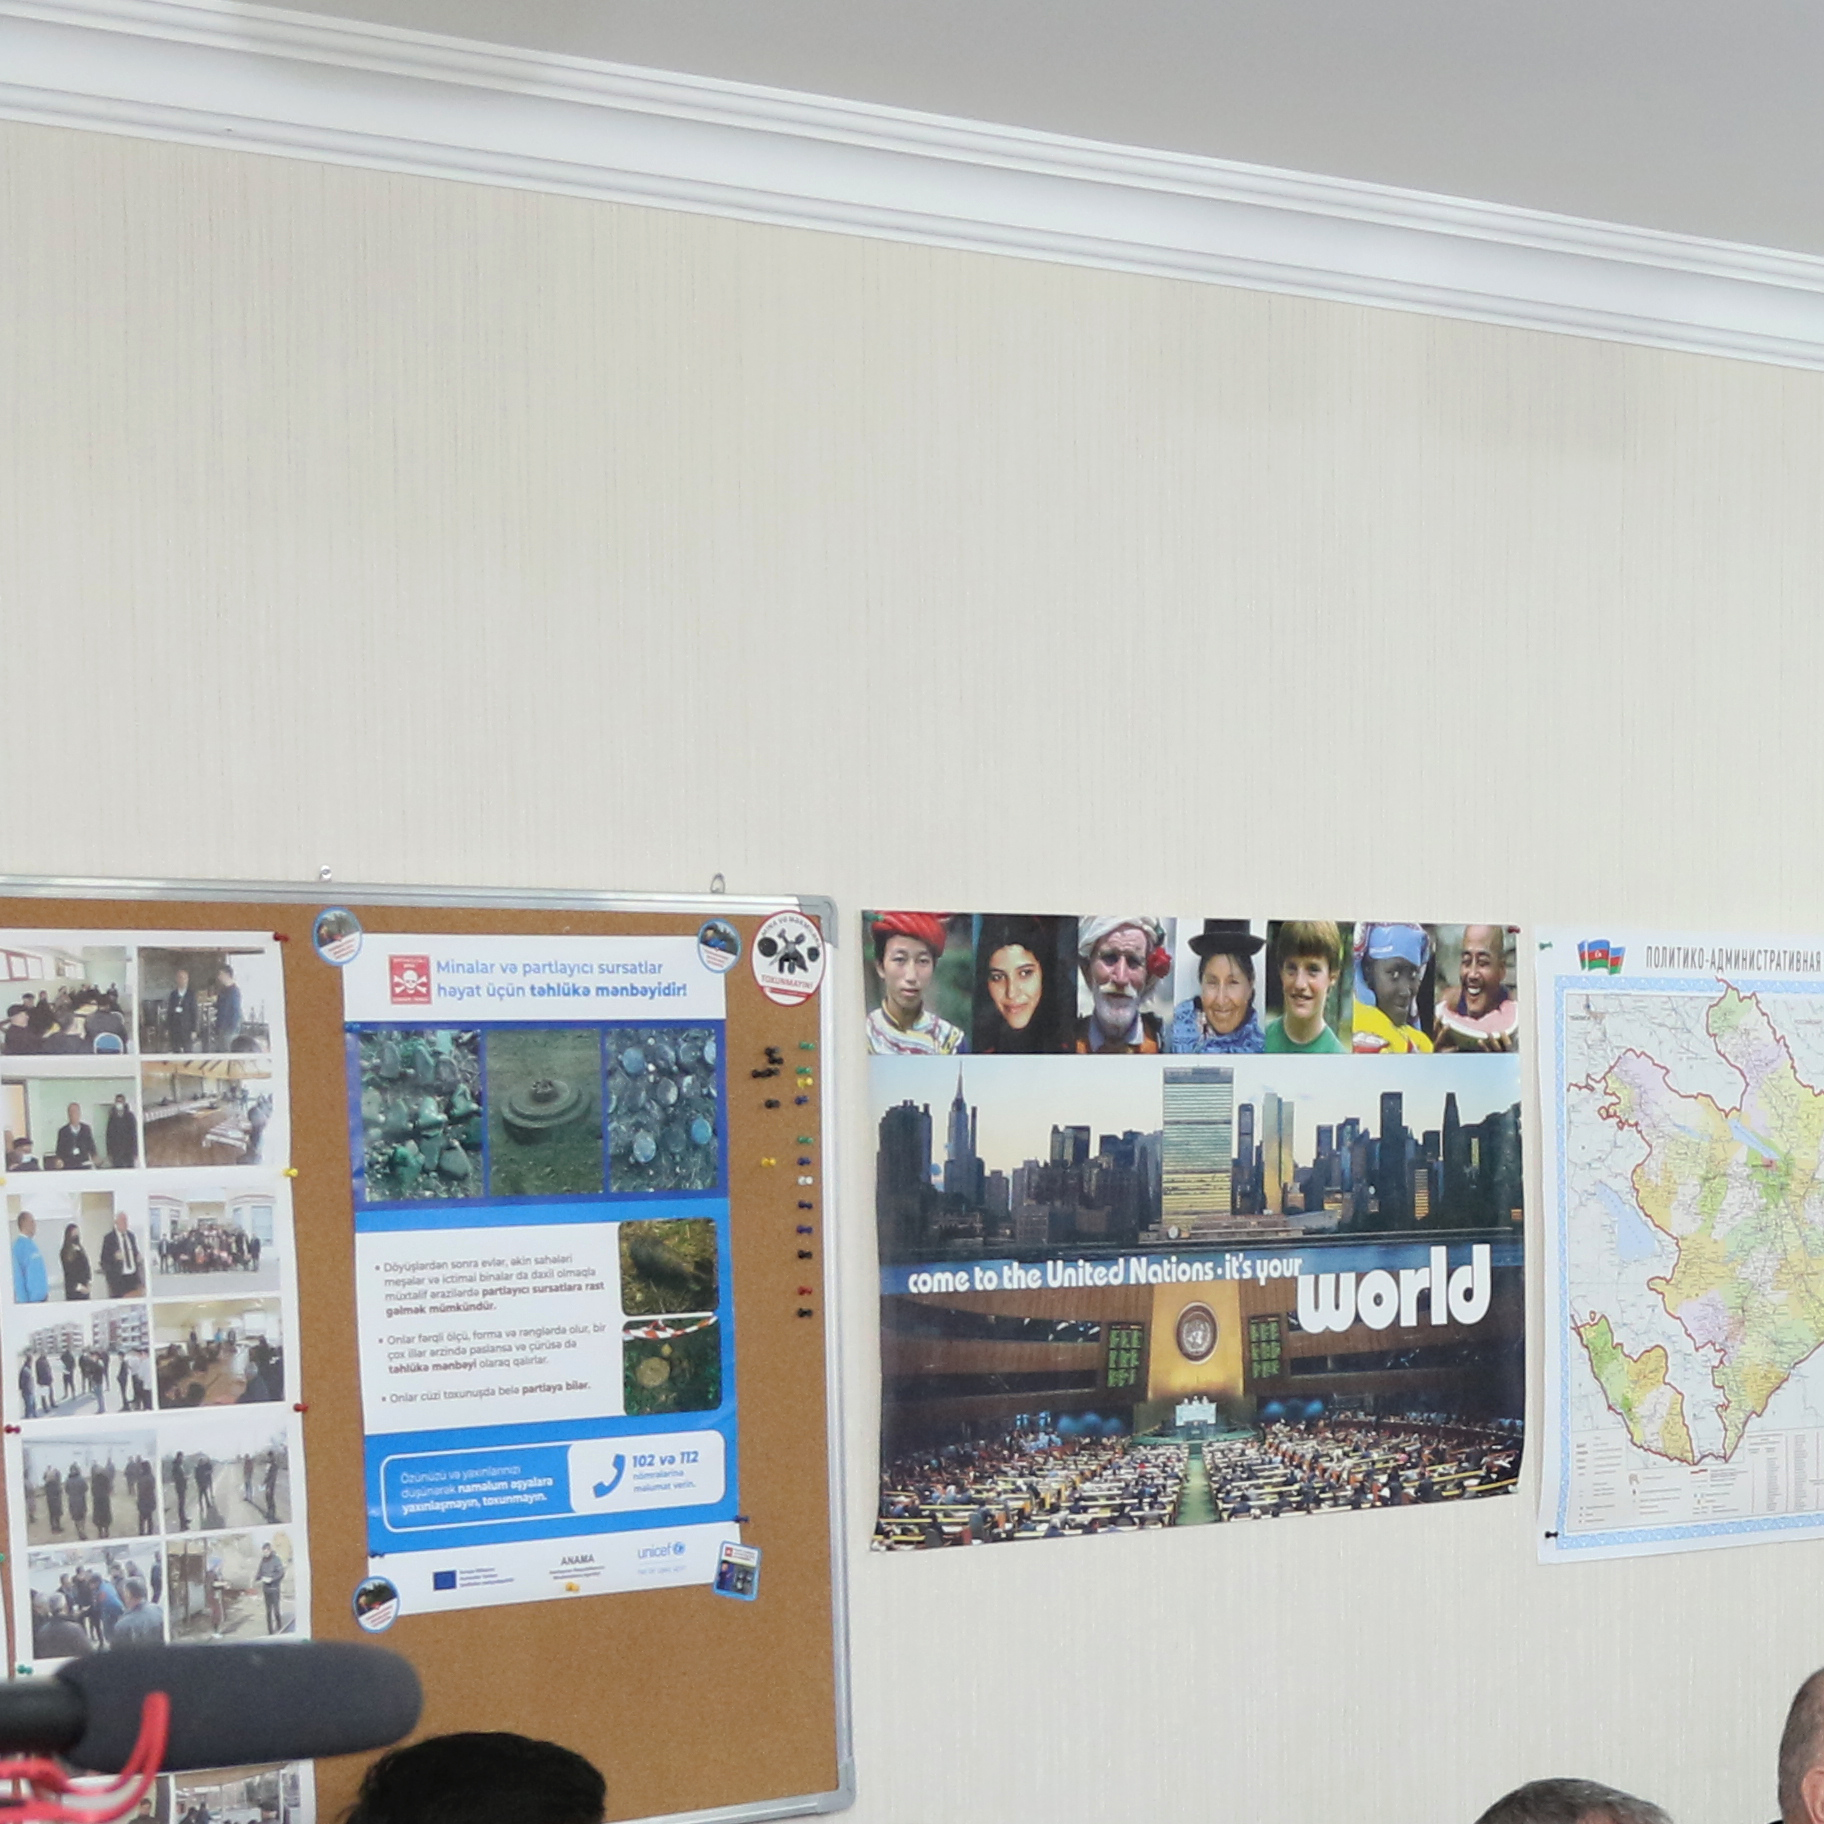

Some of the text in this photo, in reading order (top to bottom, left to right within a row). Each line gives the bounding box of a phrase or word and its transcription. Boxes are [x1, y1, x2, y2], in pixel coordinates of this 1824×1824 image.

[436, 961, 495, 974] Minalar
[500, 964, 519, 974] və
[523, 961, 594, 977] partlayıcı
[599, 961, 663, 974] sursatlar
[438, 981, 687, 1001] həyat üçün təhlükə mənbəyidir!
[908, 1253, 1302, 1293] come to the United Nations it's your
[1297, 1244, 1490, 1334] world
[632, 1451, 698, 1468] 102 və 112
[638, 1543, 671, 1559] unicef
[561, 1555, 595, 1565] ANAMA
